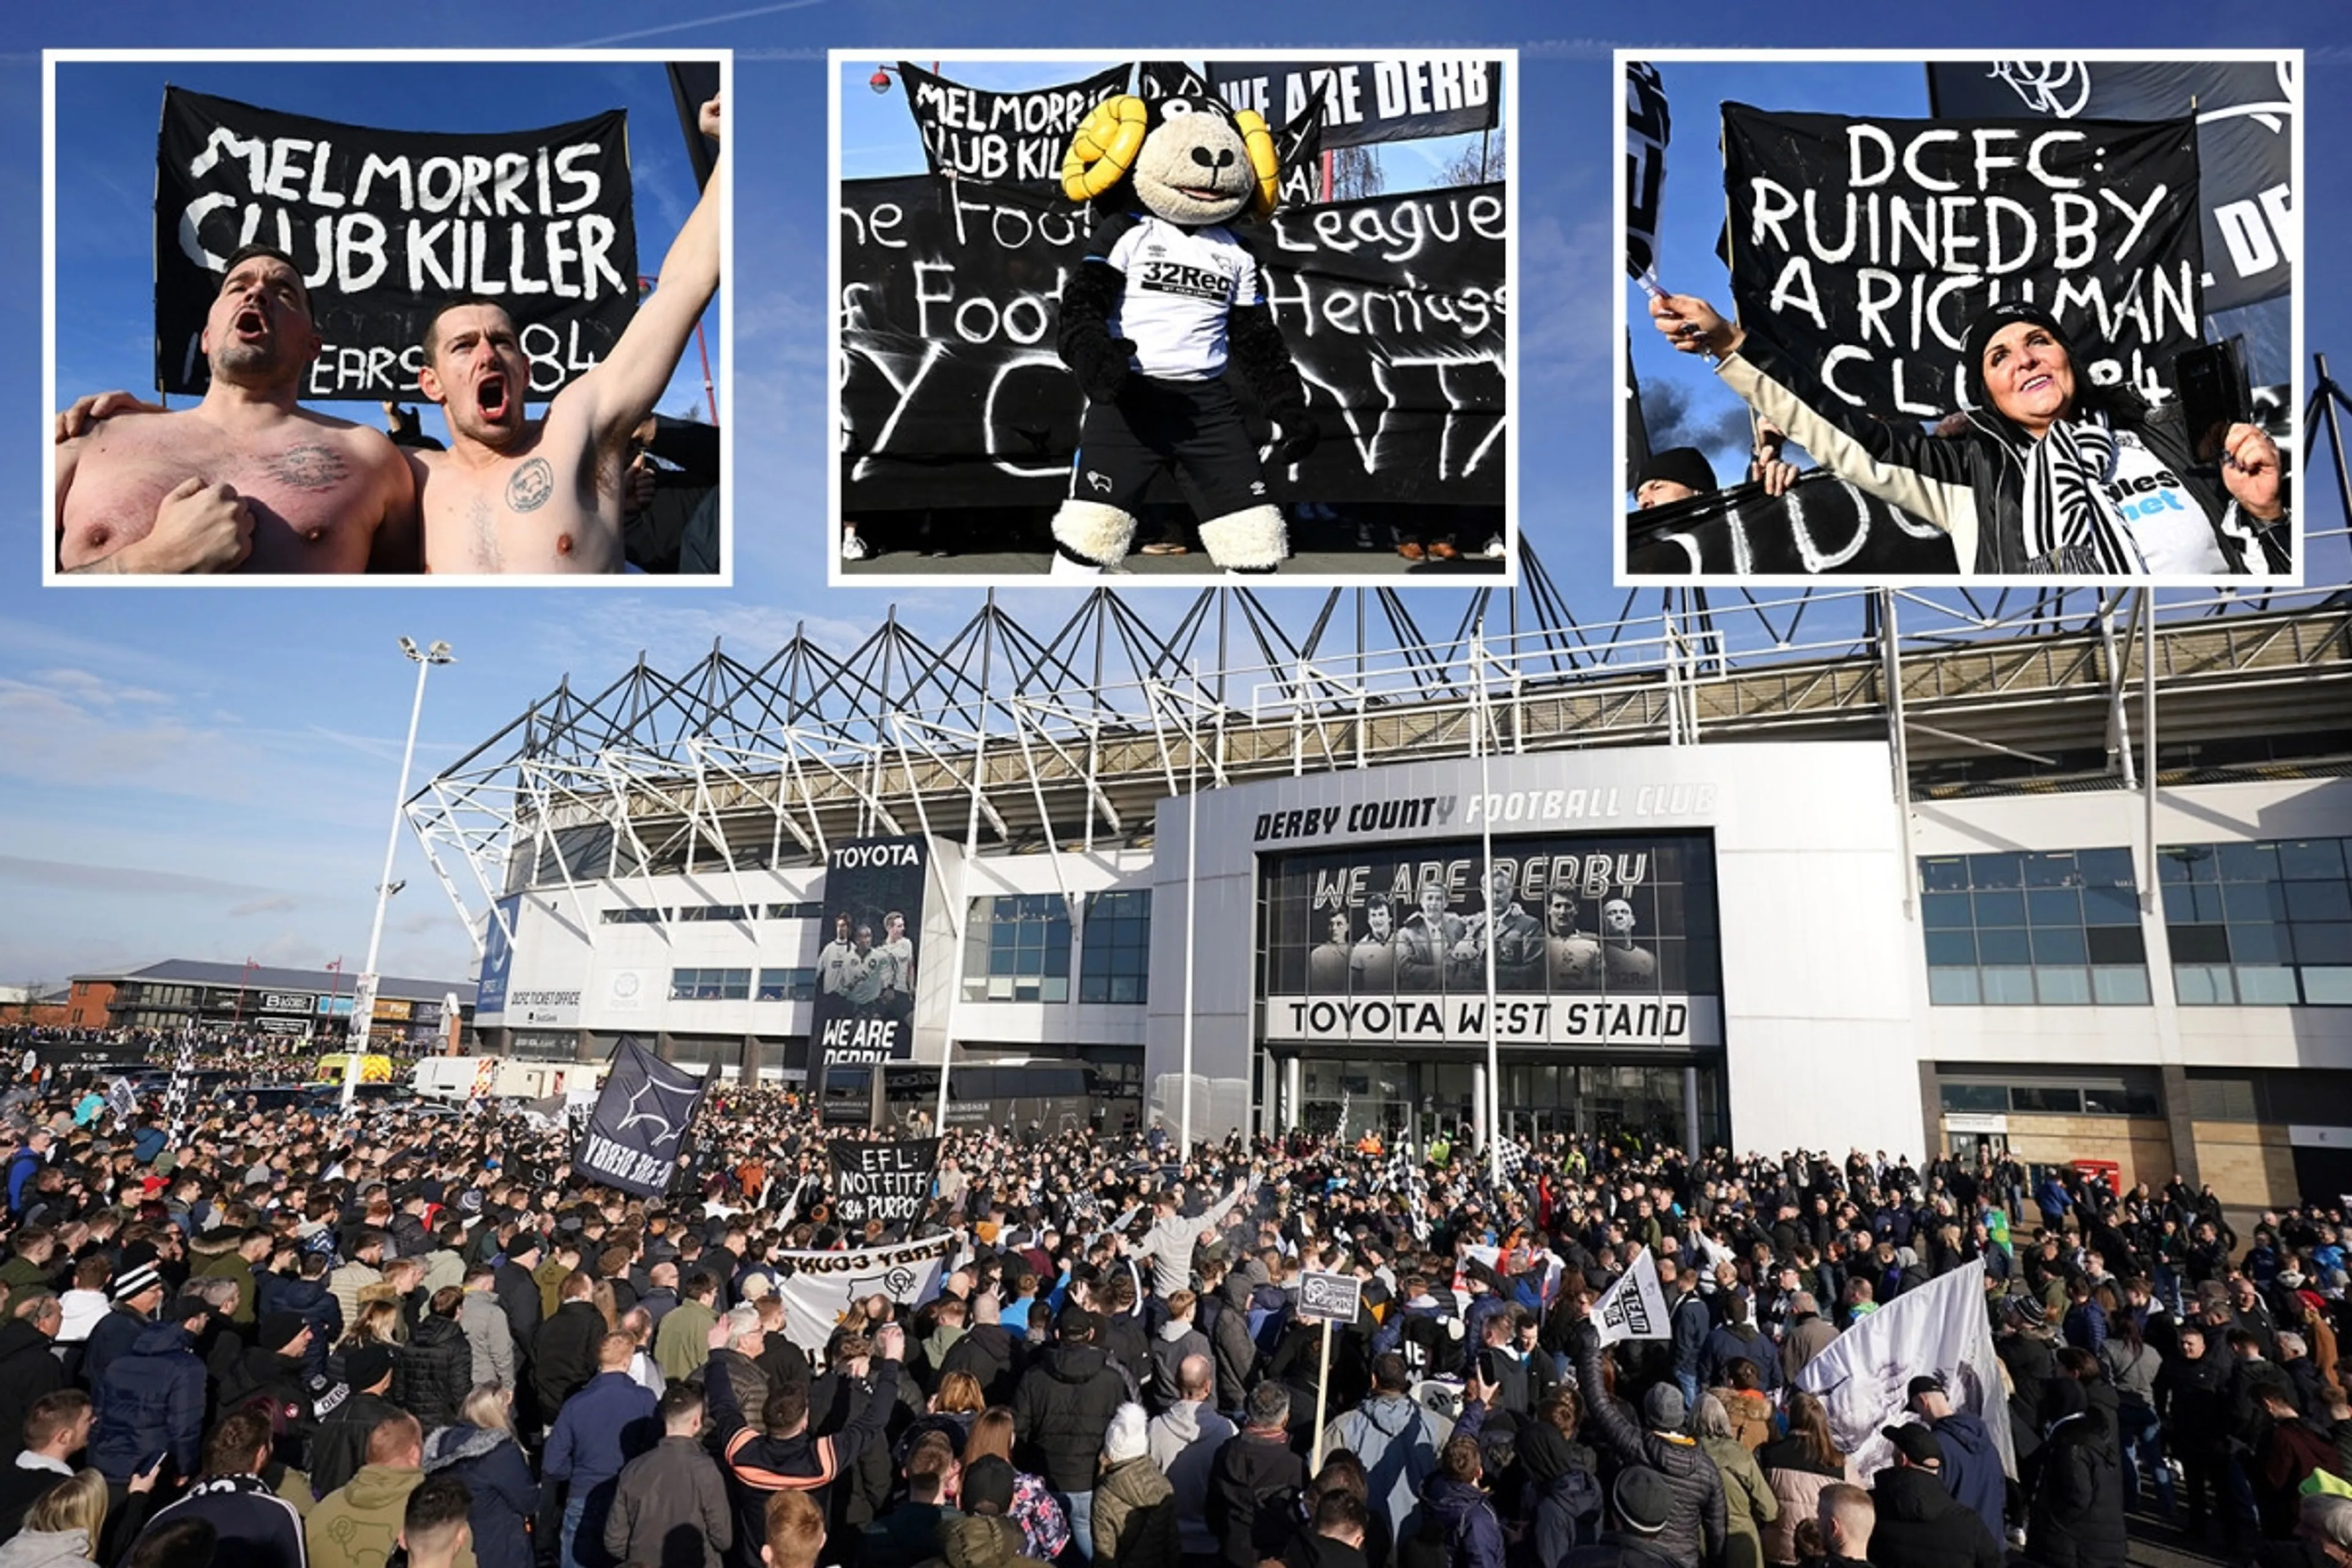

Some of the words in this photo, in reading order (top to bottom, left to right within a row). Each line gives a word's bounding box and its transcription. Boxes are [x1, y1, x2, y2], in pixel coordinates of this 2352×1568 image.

[918, 82, 986, 132] MEL
[1286, 66, 1363, 127] ARE
[1373, 61, 1488, 119] DERB
[190, 126, 345, 208] MEL
[353, 143, 601, 217] MORRIS
[1846, 124, 2106, 191] DCFC:
[1270, 195, 1506, 262] League
[1751, 177, 2037, 274] RUINED
[2052, 184, 2168, 270] BY
[407, 213, 628, 301] KILLER
[1770, 256, 1826, 330] A
[2051, 258, 2198, 344] MAN
[310, 344, 423, 394] EARS
[1254, 806, 1341, 842] DERBY
[1346, 796, 1457, 832] COUNTY
[1466, 788, 1622, 823] FOOTBALL
[1635, 783, 1716, 816] CLUB
[834, 845, 919, 869] TOYOTA
[1313, 865, 1371, 910] WE
[1387, 859, 1471, 905] ARE
[823, 1019, 853, 1047] WE
[851, 1019, 899, 1048] ARE
[1289, 1001, 1444, 1034] TOYOTA
[1458, 1003, 1552, 1035] WEST
[1566, 1003, 1687, 1036] STAND
[840, 1170, 881, 1195] NOT
